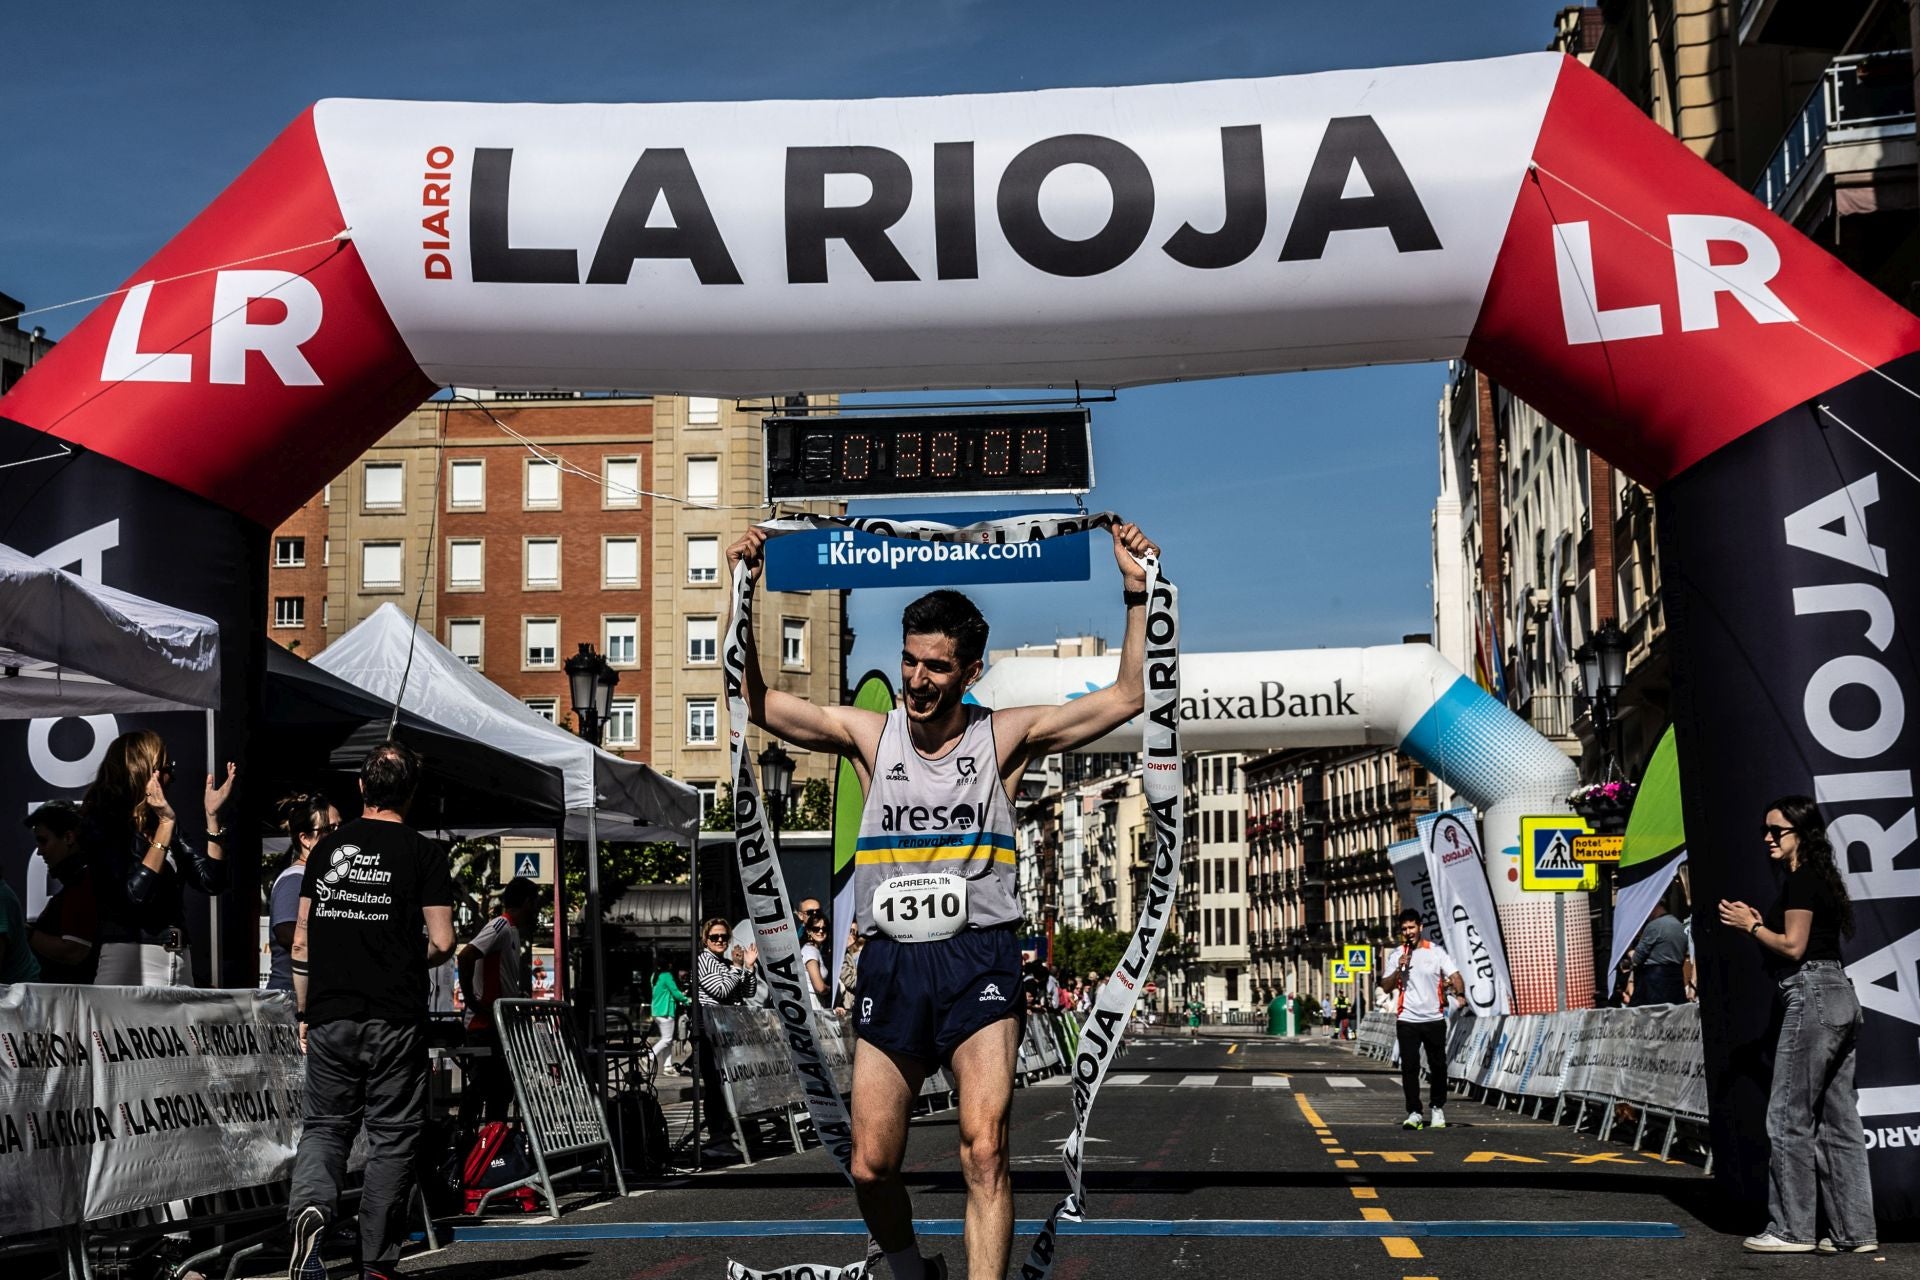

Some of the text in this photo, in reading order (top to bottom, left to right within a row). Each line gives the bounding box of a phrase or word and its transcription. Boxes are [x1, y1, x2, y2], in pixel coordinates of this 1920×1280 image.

[424, 145, 454, 281] DIARIO
[470, 114, 1444, 285] LA RIOJA
[1552, 213, 1800, 346] LR
[101, 269, 324, 387] LR
[831, 541, 1042, 570] Kirolprobak.com
[1180, 678, 1360, 721] aixaBank
[1784, 471, 1920, 902] RIOJA
[1148, 697, 1178, 758] LA
[1147, 762, 1177, 771] DIARIO
[898, 835, 965, 849] renovables
[1575, 839, 1602, 848] hotel
[331, 888, 392, 905] TuResultado
[747, 866, 786, 925] LA
[889, 878, 938, 889] CARRERA
[1121, 927, 1157, 980] LA
[1147, 795, 1178, 921] RIOJA
[315, 906, 389, 921] Kirolprobak.com
[879, 892, 960, 922] 1310
[758, 923, 789, 936] DIARIO
[1116, 970, 1135, 991] DIARIO
[99, 1026, 190, 1063] LA RIOJA
[210, 1024, 261, 1057] RIOJA
[55, 1106, 117, 1146] RIOJA
[123, 1091, 213, 1136] LA RIOJA
